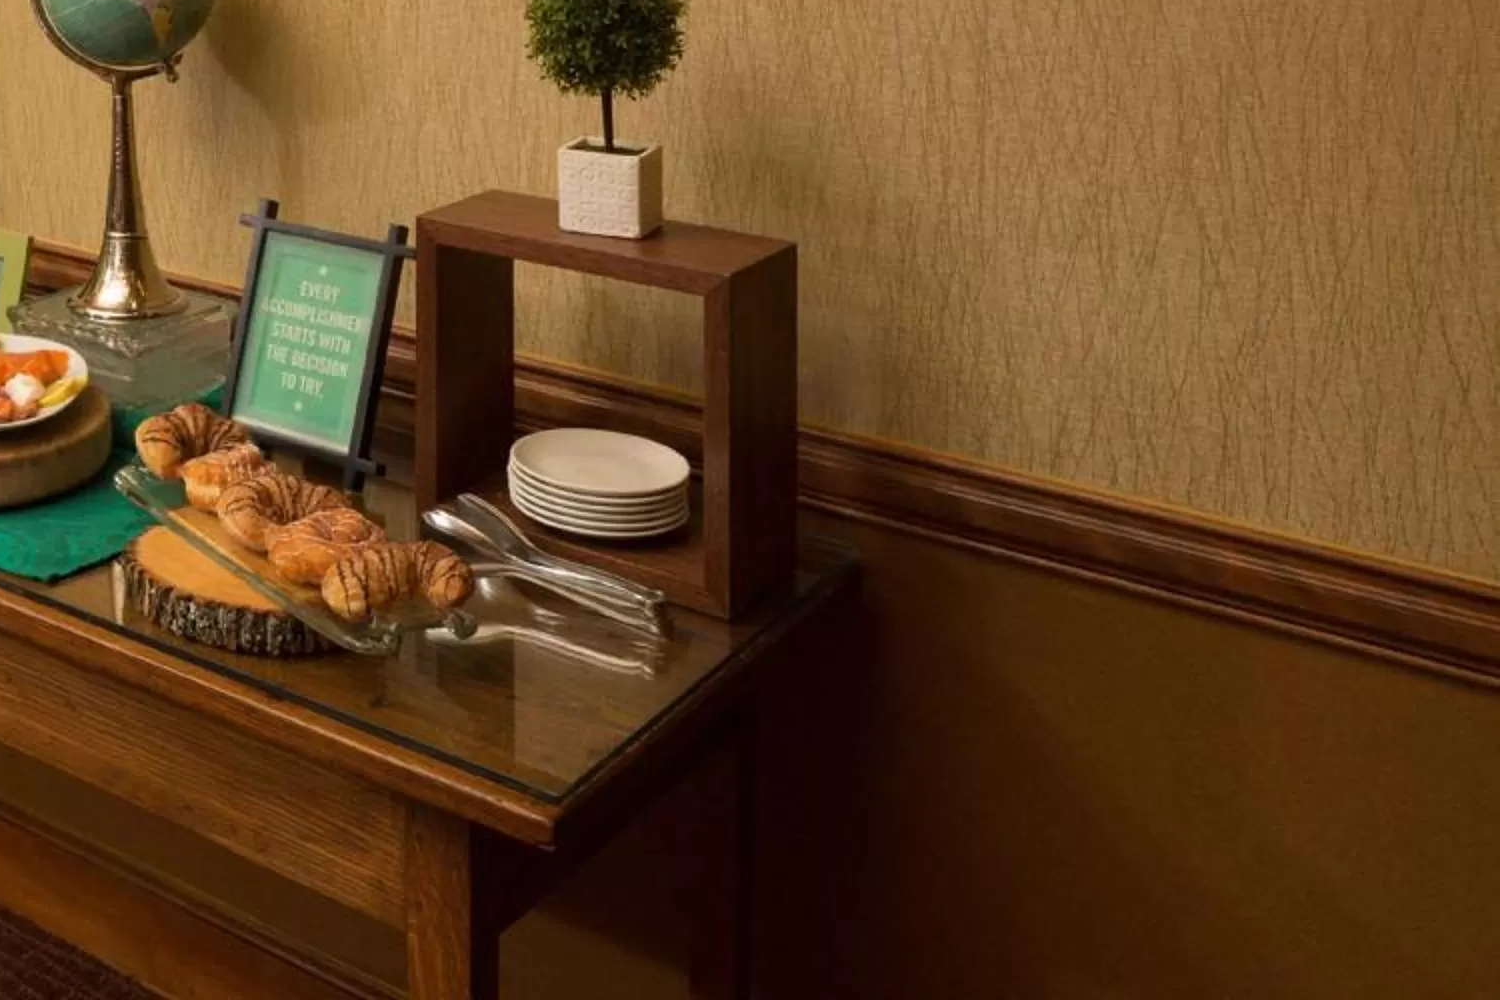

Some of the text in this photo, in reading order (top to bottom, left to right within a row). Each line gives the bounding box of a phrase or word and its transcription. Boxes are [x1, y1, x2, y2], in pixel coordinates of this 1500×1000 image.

[300, 280, 340, 303] EVERY
[272, 321, 350, 355] STARTS WITH
[267, 343, 348, 377] THE DECISION
[281, 372, 297, 389] TO
